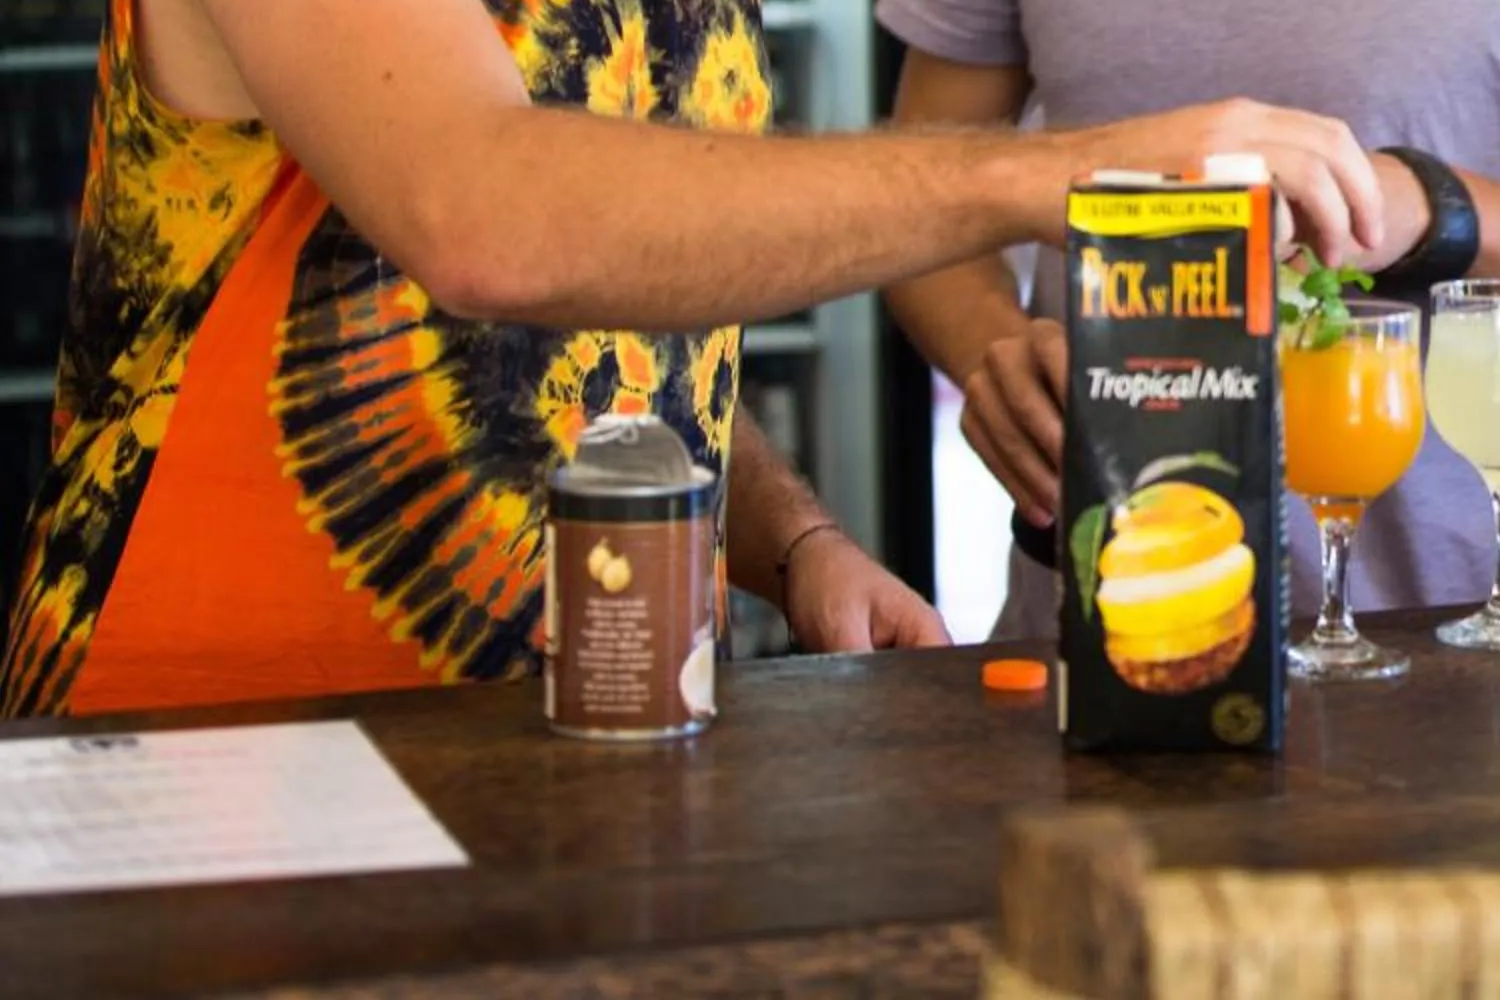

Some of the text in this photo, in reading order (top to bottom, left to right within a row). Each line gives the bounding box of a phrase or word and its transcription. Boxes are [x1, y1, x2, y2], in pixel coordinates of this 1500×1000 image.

[1172, 247, 1233, 319] PEEL
[1087, 365, 1260, 408] Tropical Mix
